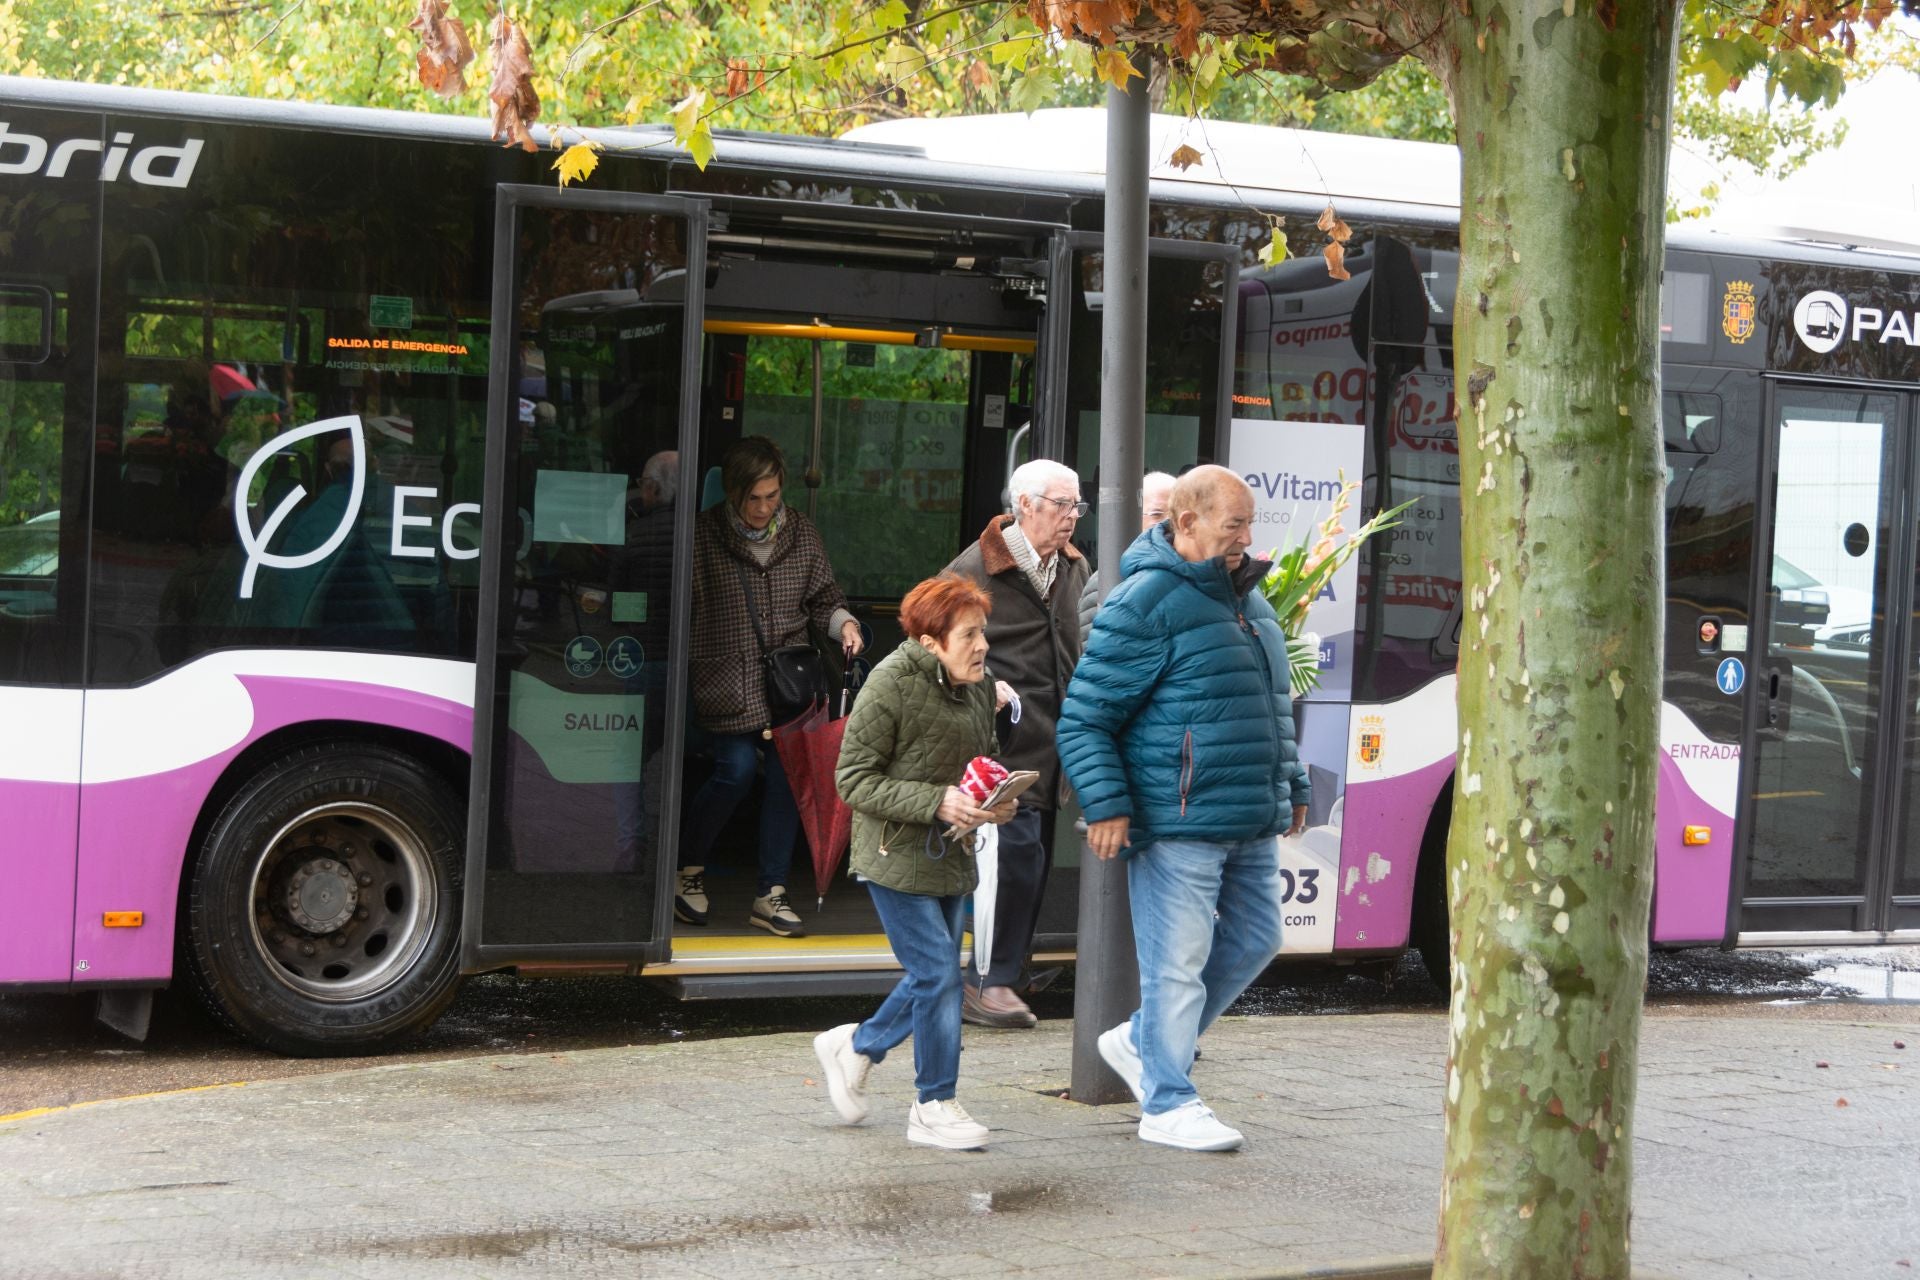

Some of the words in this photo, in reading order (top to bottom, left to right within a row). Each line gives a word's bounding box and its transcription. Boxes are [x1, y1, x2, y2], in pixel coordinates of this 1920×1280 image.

[0, 122, 205, 188] brid
[328, 338, 371, 349] SALIDA
[373, 340, 389, 349] DE
[391, 340, 468, 355] EMERGENCIA
[1231, 394, 1272, 407] RGENCIA
[564, 712, 640, 732] SALIDA
[1670, 743, 1741, 760] ENTRADA
